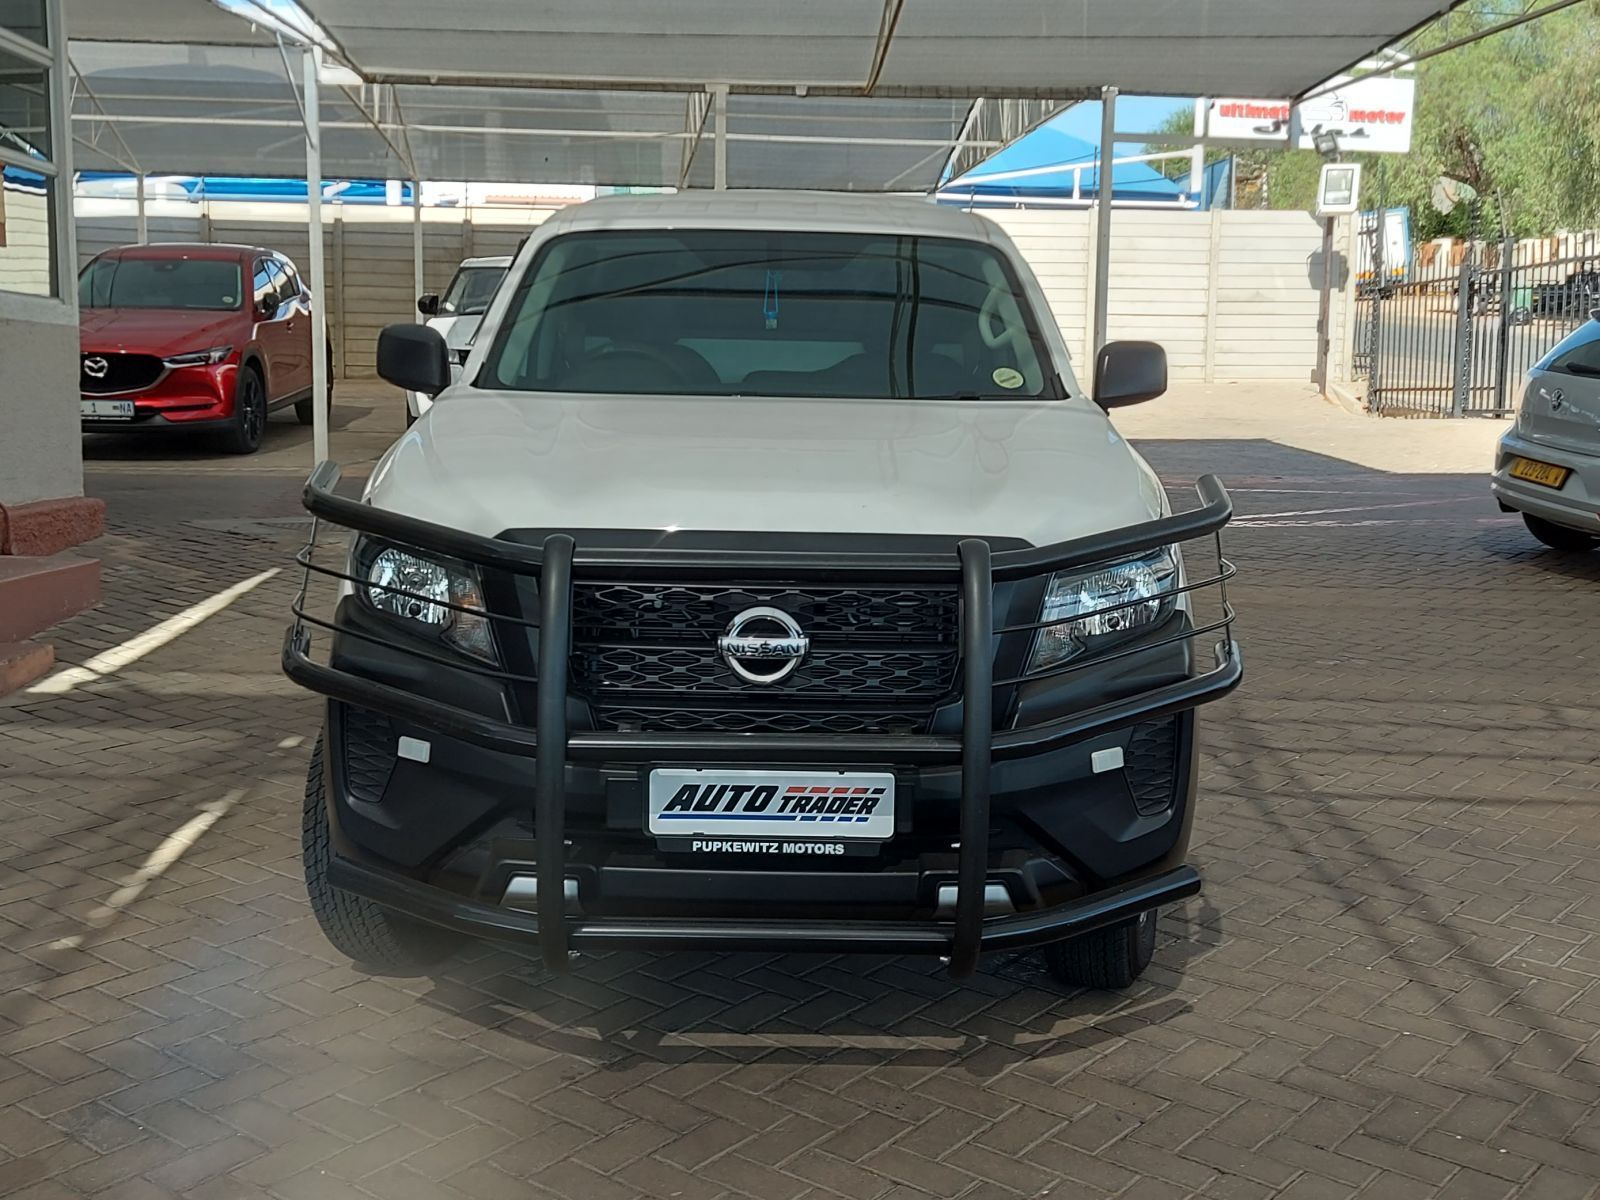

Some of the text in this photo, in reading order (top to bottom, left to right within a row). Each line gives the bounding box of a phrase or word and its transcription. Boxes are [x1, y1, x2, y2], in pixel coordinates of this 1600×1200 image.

[1219, 103, 1406, 124] ultimat motor
[727, 642, 800, 656] NISSAN
[663, 784, 880, 815] AUTO TRADER
[692, 841, 845, 855] PUPKEWITZ MOTORS
